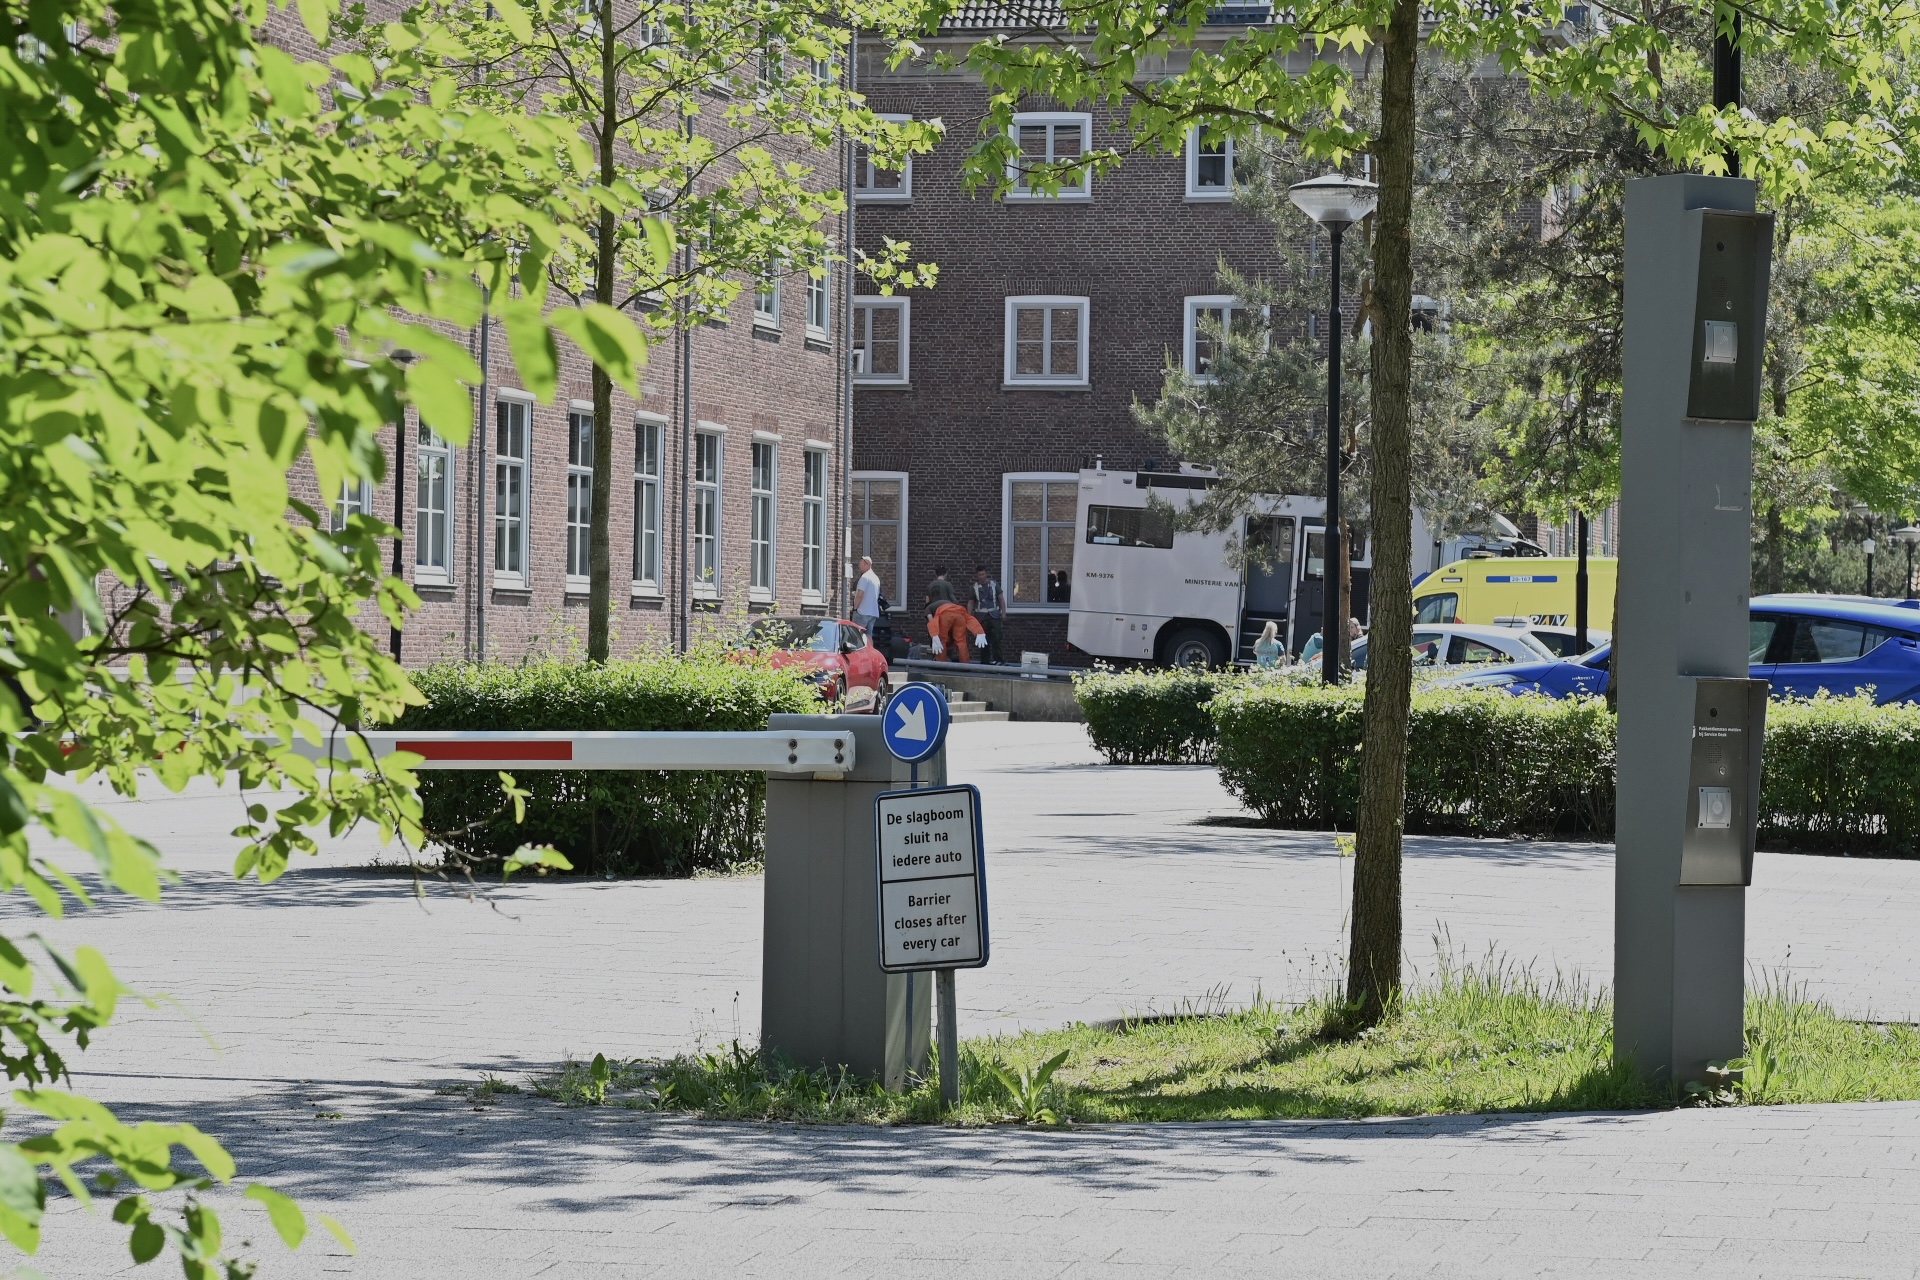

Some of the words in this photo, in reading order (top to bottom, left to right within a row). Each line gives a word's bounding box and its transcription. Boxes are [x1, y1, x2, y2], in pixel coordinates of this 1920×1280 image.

[1184, 578, 1222, 587] MINISTERIE
[887, 813, 903, 826] De
[906, 808, 964, 825] slagboom
[904, 831, 931, 845] sluit
[934, 832, 949, 843] na
[892, 853, 931, 867] iedere
[935, 851, 962, 864] auto
[908, 893, 951, 907] Barrier
[894, 916, 932, 930] closes
[936, 913, 967, 927] after
[903, 937, 937, 951] every
[940, 936, 960, 948] car
